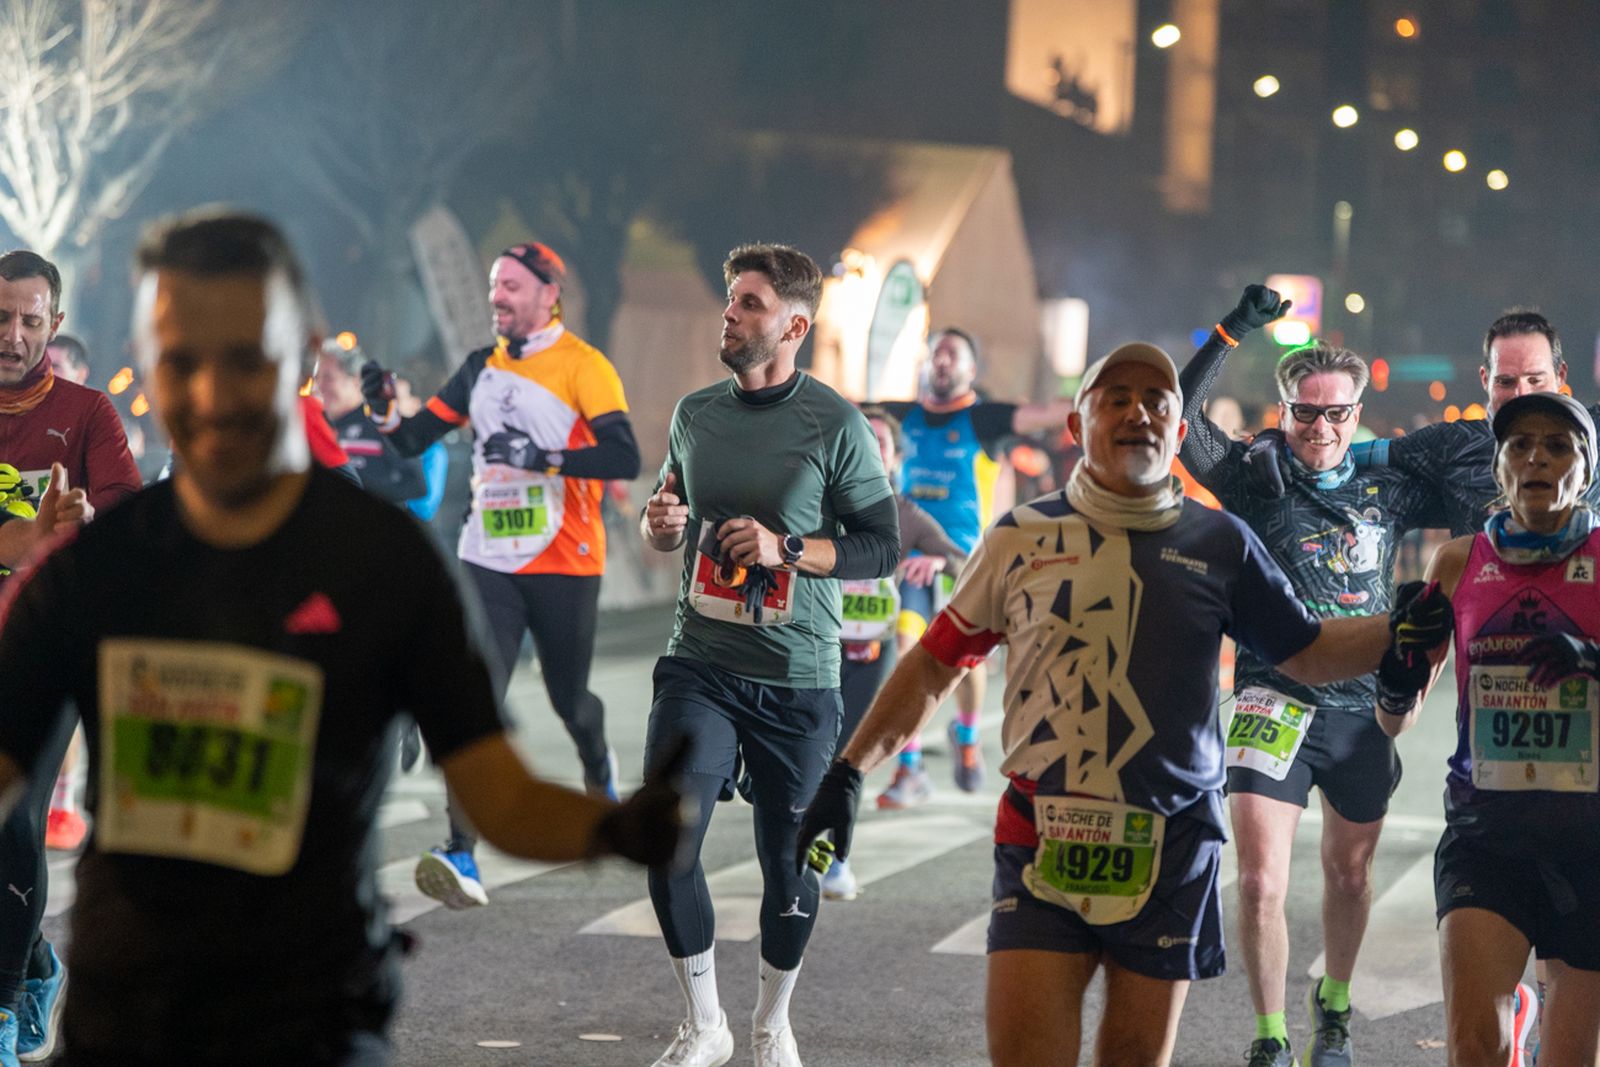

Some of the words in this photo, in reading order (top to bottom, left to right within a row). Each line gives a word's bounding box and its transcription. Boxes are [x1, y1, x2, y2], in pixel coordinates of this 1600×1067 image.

[493, 508, 534, 531] 3107
[1572, 571, 1589, 580] AC
[1510, 611, 1547, 631] AC
[1495, 680, 1530, 692] NOCHE
[1483, 694, 1504, 707] SAN
[1506, 694, 1547, 709] ANTÓN
[1492, 711, 1572, 748] 9297
[1097, 815, 1114, 828] DE
[1067, 826, 1112, 842] ANTÓN
